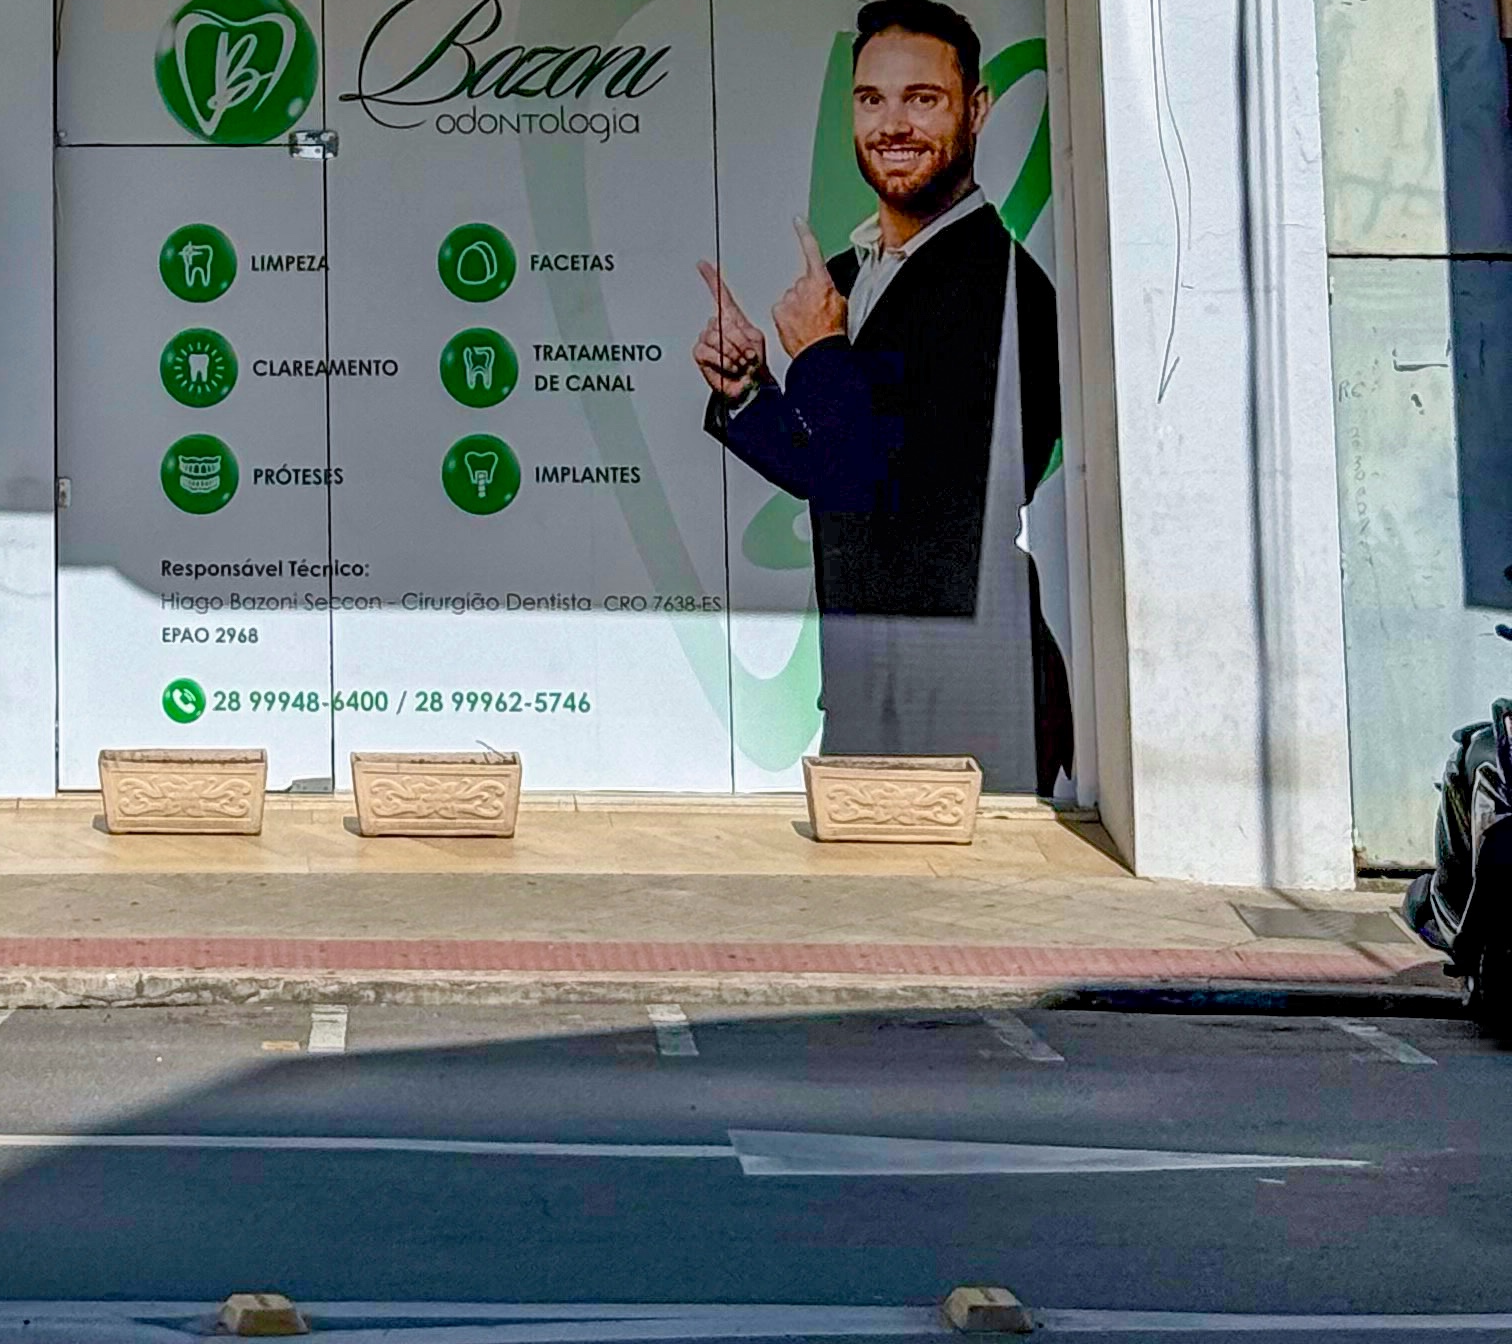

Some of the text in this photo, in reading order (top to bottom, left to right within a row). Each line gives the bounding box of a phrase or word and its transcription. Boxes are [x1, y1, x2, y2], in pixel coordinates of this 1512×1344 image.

[251, 255, 330, 272] LIMPEZA
[530, 254, 615, 272] FACETAS
[534, 344, 662, 362] TRATAMENTO
[252, 359, 399, 378] CLAREAMENTO
[535, 374, 635, 392] DE CANAL
[252, 465, 344, 486] PRÓTESES
[536, 466, 641, 484] IMPLANTES
[161, 558, 370, 580] Responsável Técnico:
[161, 592, 224, 614] Hiago
[230, 592, 297, 611] Bazoni
[304, 592, 382, 611] Seccon
[402, 592, 499, 614] Cirurgião
[506, 593, 591, 611] Dentista
[604, 595, 647, 612] CRO
[653, 595, 722, 612] 7638-ES
[162, 627, 258, 643] EPAO 2968
[213, 691, 241, 711] 28
[249, 691, 388, 712] 99948-6400
[415, 692, 443, 712] 28
[452, 692, 590, 713] 99962-5746
